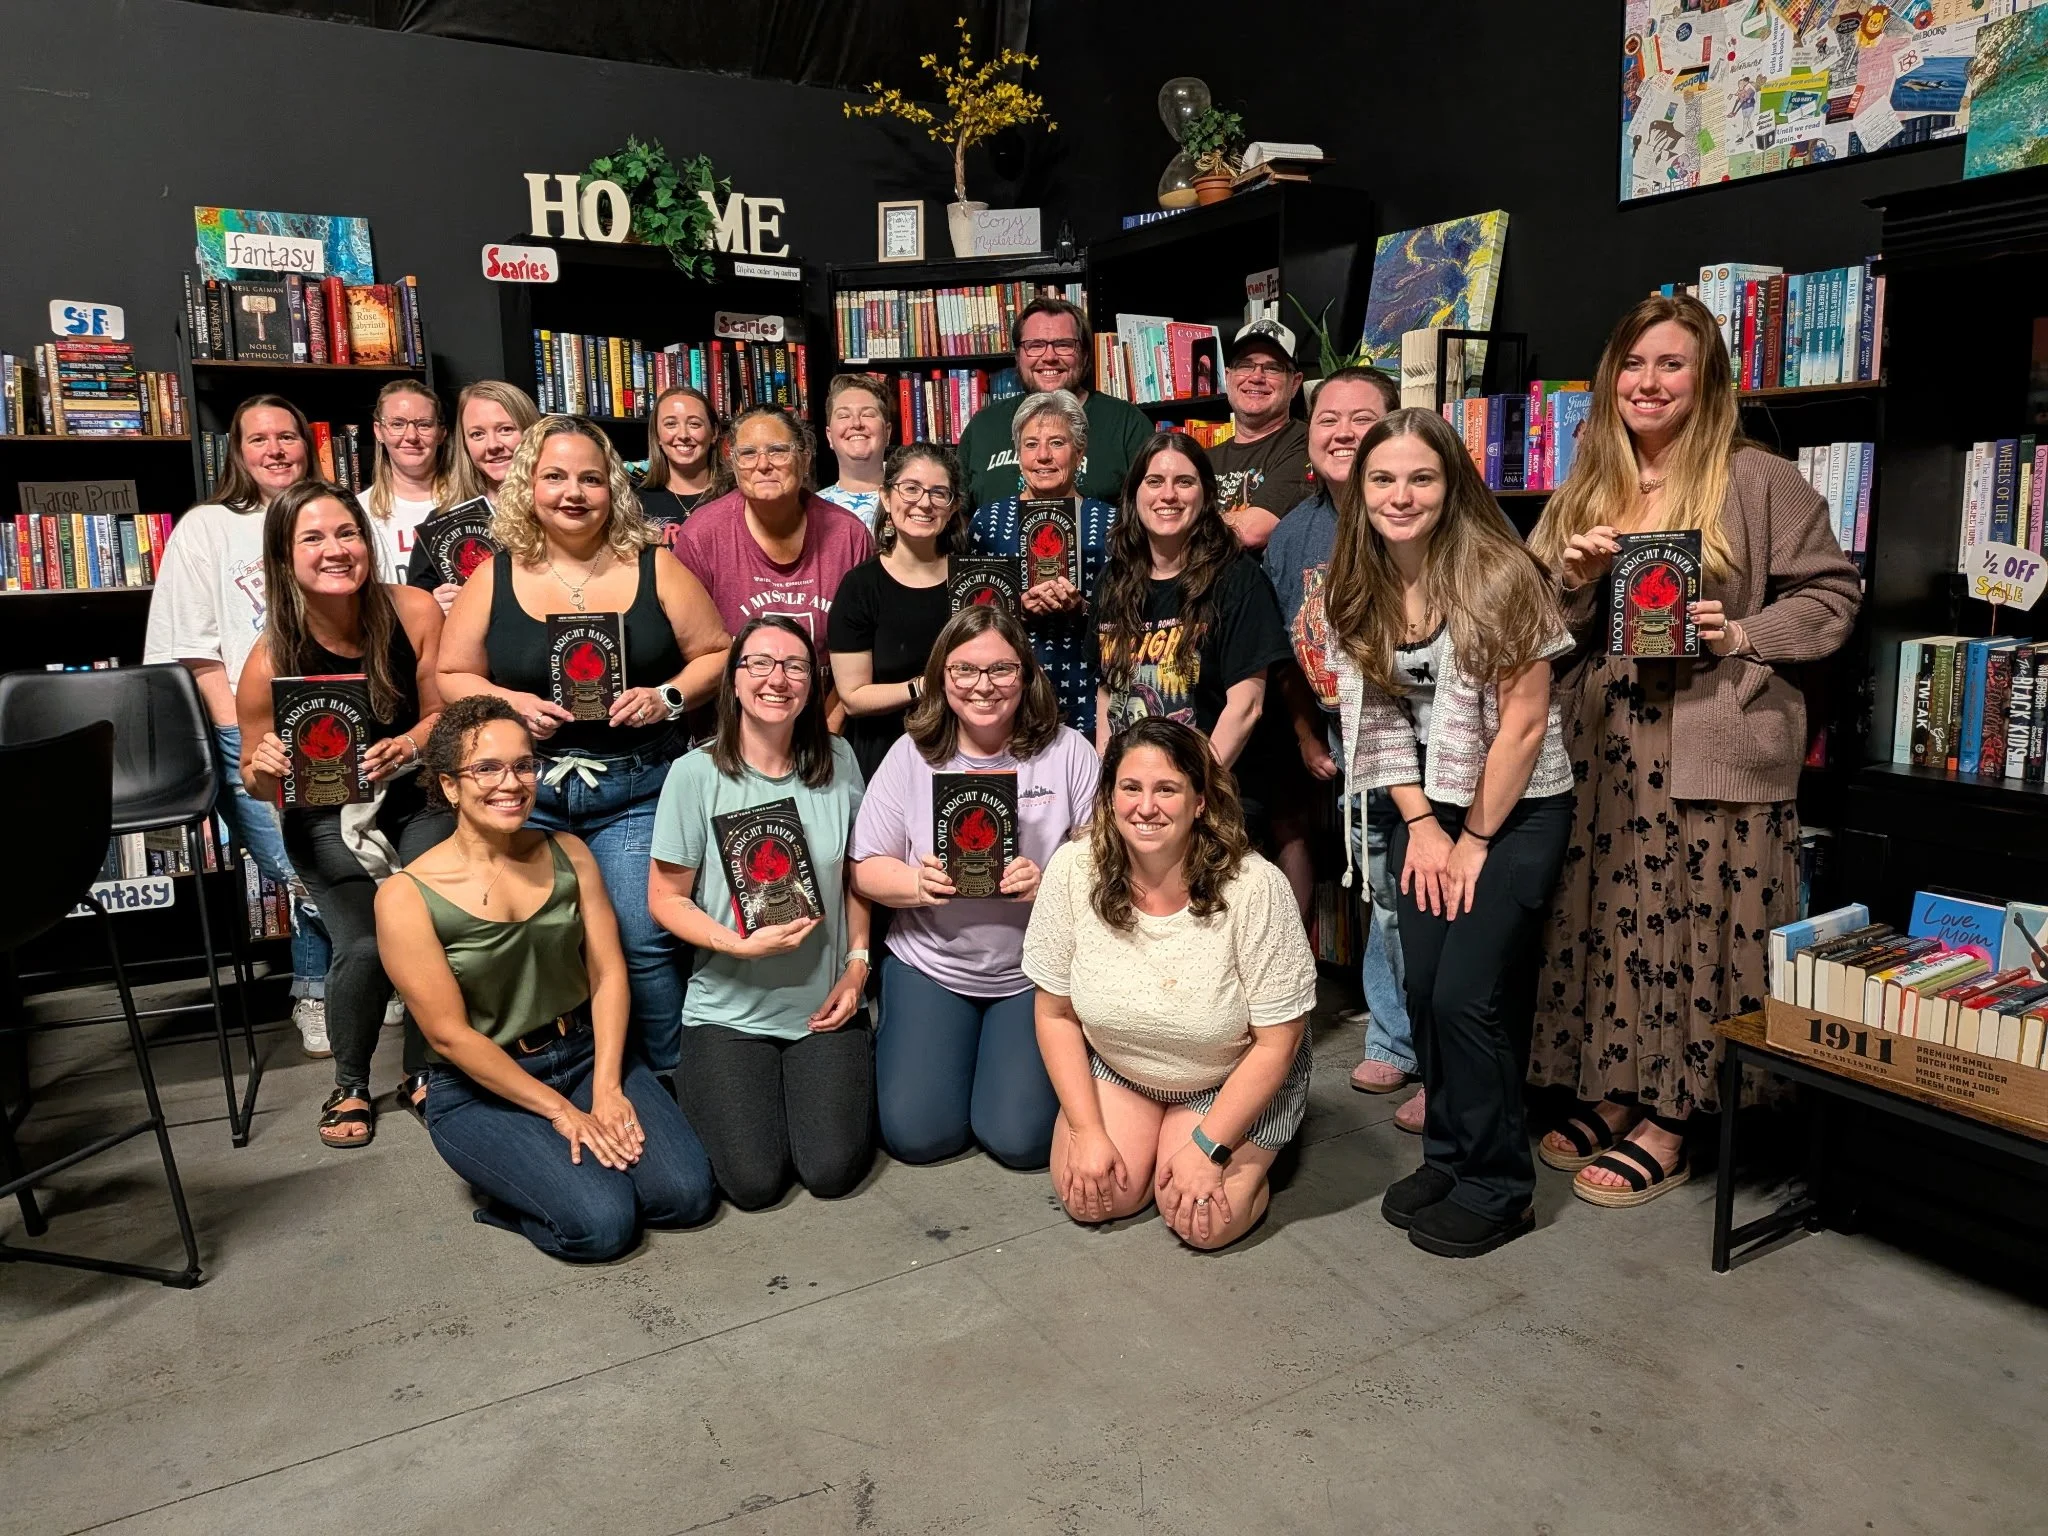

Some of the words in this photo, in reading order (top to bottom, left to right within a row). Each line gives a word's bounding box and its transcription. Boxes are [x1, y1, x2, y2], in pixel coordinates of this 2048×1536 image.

[977, 212, 1032, 237] Cozy
[229, 234, 315, 272] fantasy
[975, 235, 1038, 252] Mysteries
[486, 246, 551, 281] Scaries
[231, 285, 250, 293] NEIL
[1717, 267, 1729, 312] Ruthless
[1818, 283, 1826, 311] ARCHER'S
[1831, 281, 1839, 309] ARCHER'S
[1848, 278, 1857, 305] TRAVIS
[350, 321, 386, 331] Labyrinth
[356, 312, 377, 320] Rose
[718, 315, 778, 336] Scaries
[1816, 311, 1824, 329] VOICE
[1829, 310, 1837, 327] VOICE
[1863, 303, 1874, 328] Another
[249, 343, 277, 351] NORSE
[534, 342, 541, 356] NO
[1861, 330, 1872, 342] Life
[238, 352, 289, 360] MYTHOLOGY
[535, 359, 543, 381] EXIT
[1831, 446, 1841, 480] DANIELLE
[1847, 446, 1857, 484] DANIELLE
[1860, 449, 1870, 486] DANIELLE
[1982, 461, 1990, 474] The
[1998, 444, 2013, 484] WHEELS
[2034, 448, 2046, 485] OPENING
[1504, 476, 1519, 484] ANA
[1829, 482, 1838, 501] STEEL
[1978, 476, 1989, 510] Intelligence
[2033, 486, 2042, 498] TO
[24, 486, 82, 513] Large
[85, 483, 132, 512] Print
[1845, 486, 1854, 506] STEEL
[1858, 488, 1867, 508] STEEL
[1996, 486, 2010, 501] OF
[110, 515, 118, 539] DANIELLE
[1023, 511, 1048, 533] BRIGHT
[1049, 512, 1072, 531] HAVEN
[1977, 512, 1987, 526] Trap
[1995, 504, 2009, 524] LIFE
[2017, 503, 2027, 545] AWAKENING
[2030, 499, 2041, 533] CHANNEL
[98, 529, 107, 545] JANCE
[438, 527, 463, 558] BRIGHT
[465, 525, 493, 540] HAVEN
[1019, 534, 1028, 559] OVER
[440, 559, 458, 585] OVER
[1021, 559, 1029, 590] BLOOD
[1619, 548, 1660, 577] BRIGHT
[1663, 549, 1694, 574] HAVEN
[2004, 556, 2040, 583] OFF
[955, 573, 987, 597] BRIGHT
[989, 574, 1013, 597] HAVEN
[1613, 578, 1626, 609] OVER
[1974, 575, 2024, 604] SALE
[739, 604, 750, 617] I
[749, 589, 807, 610] MYSELF
[808, 594, 833, 613] AM
[553, 628, 585, 652] BRIGHT
[588, 628, 615, 651] HAVEN
[1612, 612, 1624, 652] BLOOD
[1684, 622, 1696, 652] WANG
[550, 654, 561, 681] OVER
[2016, 658, 2029, 678] The
[1916, 679, 1931, 730] TWEAK
[1937, 678, 1946, 707] YOU'VE
[2009, 677, 2034, 720] BLACK
[2040, 677, 2048, 708] grayson
[284, 697, 326, 726] BRIGHT
[329, 698, 362, 724] HAVEN
[1936, 707, 1944, 725] BEEN
[1930, 727, 1945, 753] Gone
[2006, 724, 2029, 757] KIDS
[751, 806, 766, 814] TIMES
[941, 791, 978, 818] BRIGHT
[980, 792, 1010, 817] HAVEN
[731, 825, 763, 857] BRIGHT
[766, 824, 796, 844] HAVEN
[937, 819, 948, 850] OVER
[730, 858, 746, 889] OVER
[70, 883, 170, 915] ntasy
[802, 879, 817, 904] WANG
[739, 892, 757, 930] BLOOD
[1923, 901, 1980, 931] Love,
[1937, 925, 1994, 948] Mom
[1804, 1018, 1898, 1067] 1911
[1812, 1048, 1888, 1075] ESTABLISHED
[1916, 1045, 1960, 1063] PREMIUM
[1962, 1055, 1994, 1072] SMALL
[1916, 1055, 1947, 1069] BATCH
[1949, 1063, 1975, 1077] HARD
[1977, 1070, 2008, 1085] CIDER
[1915, 1067, 1942, 1080] MADE
[1943, 1073, 1970, 1087] FROM
[1971, 1082, 2001, 1096] 100%
[1915, 1077, 1945, 1090] FRESH
[1946, 1085, 1975, 1099] CIDER
